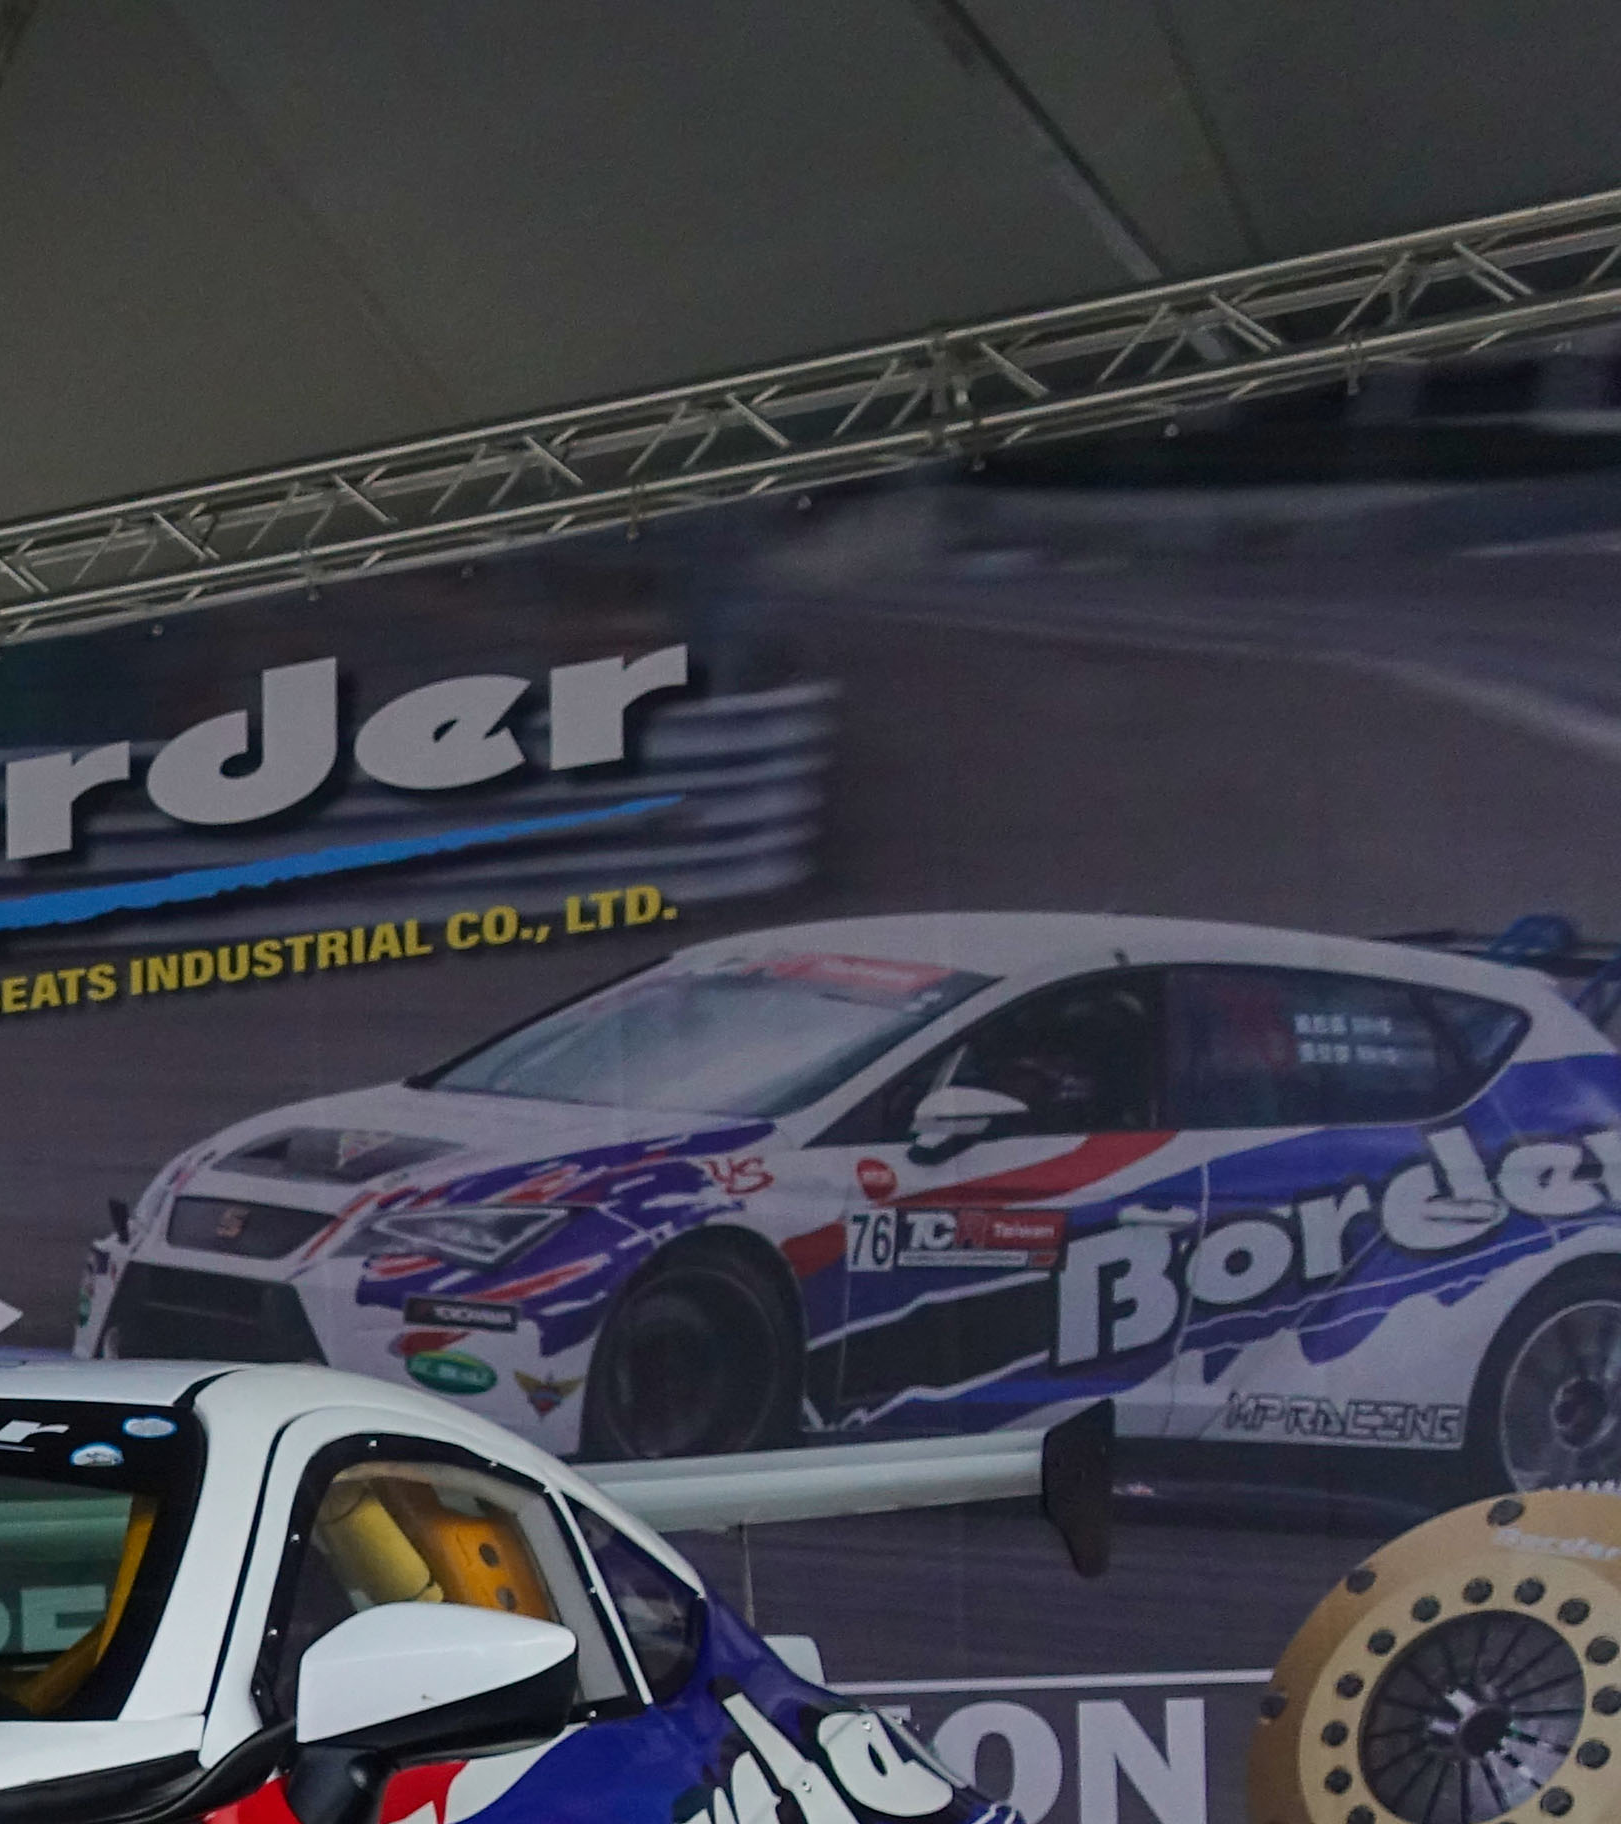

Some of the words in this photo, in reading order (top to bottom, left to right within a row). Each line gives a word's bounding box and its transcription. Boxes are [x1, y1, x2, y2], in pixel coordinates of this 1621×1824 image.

[130, 917, 432, 992] INDUSTRIAL
[445, 905, 549, 953] CO.,
[564, 884, 678, 935] LTD.
[852, 1214, 893, 1266] 76
